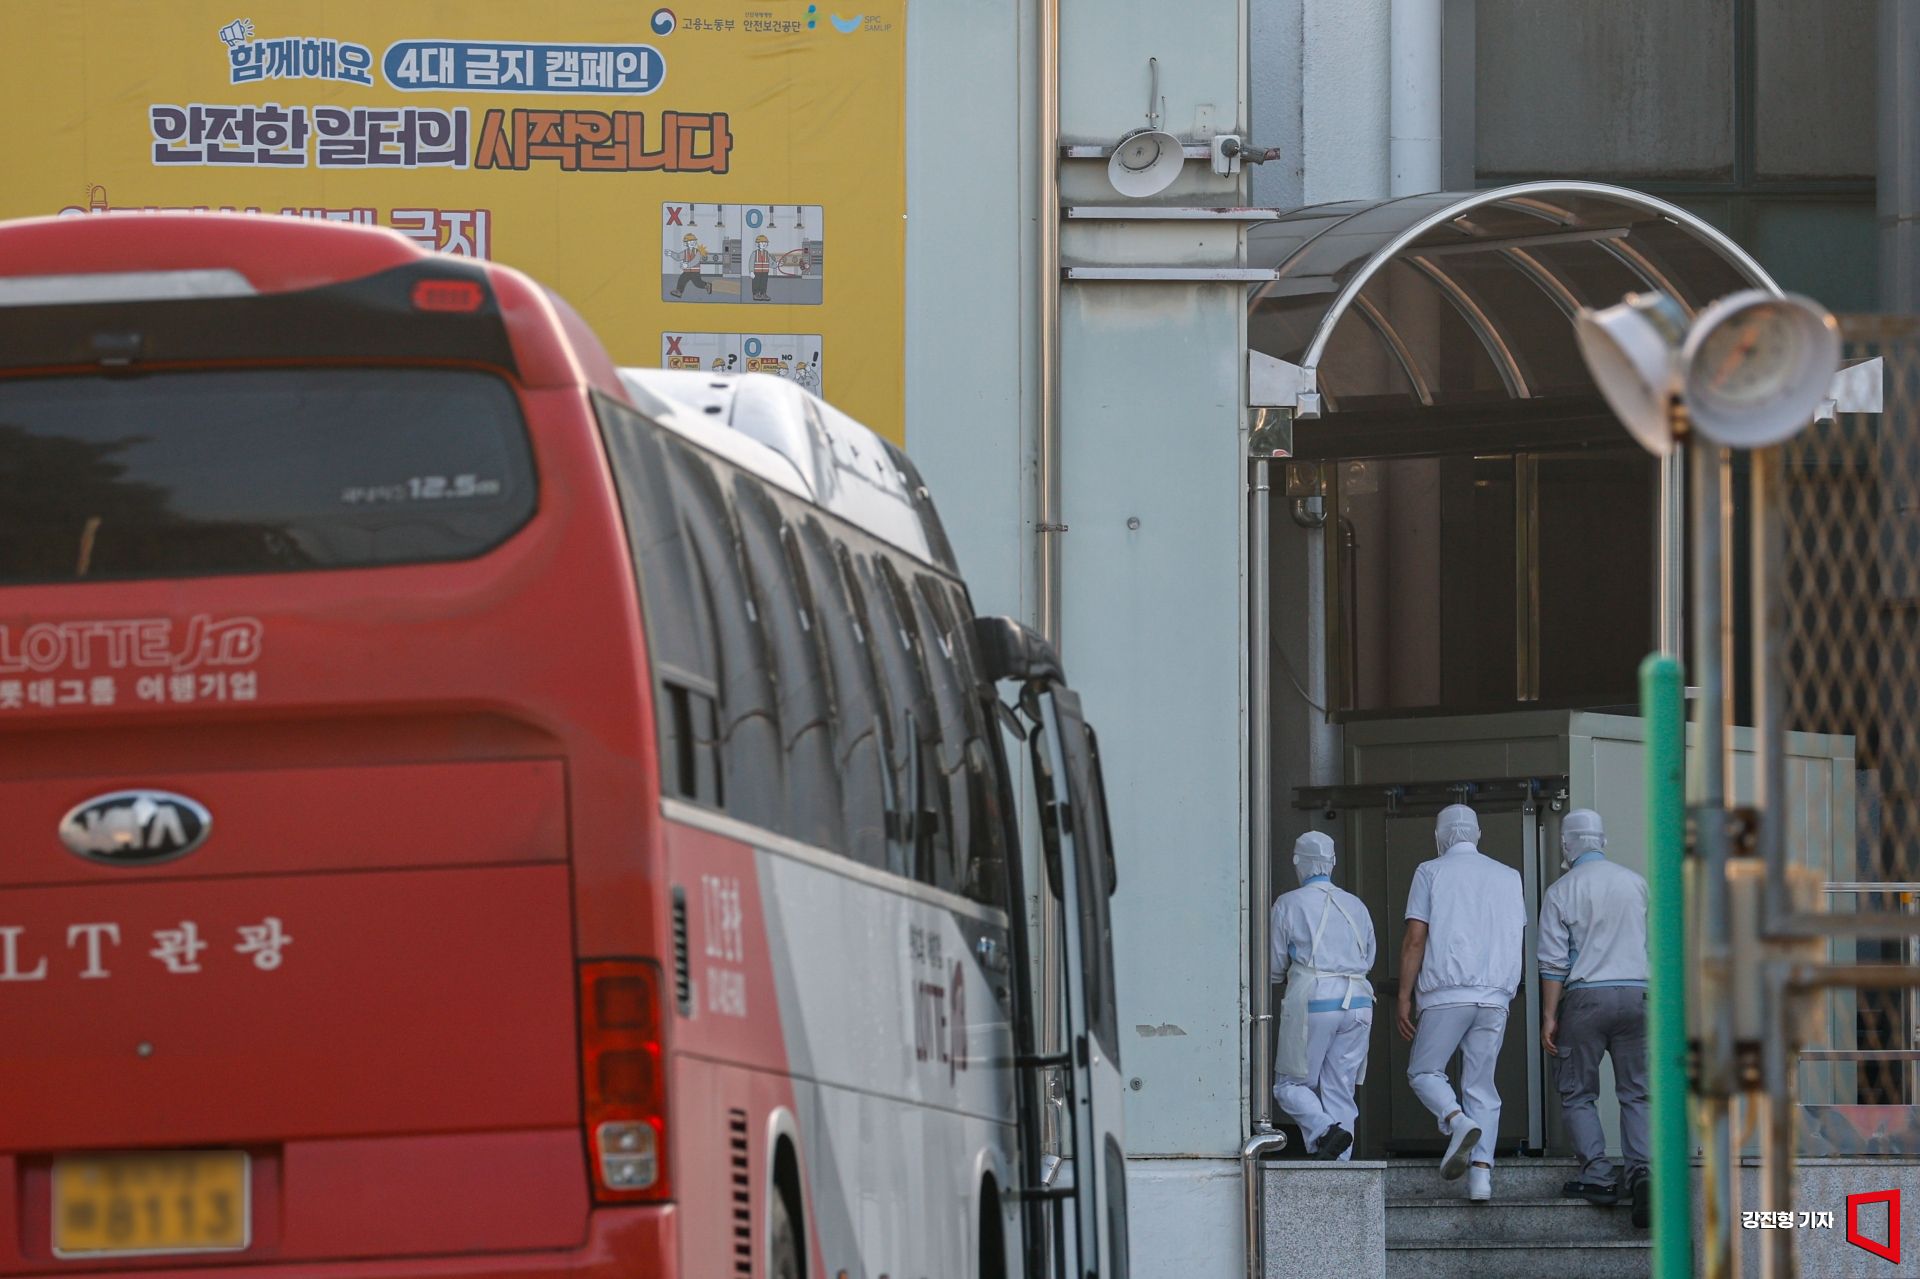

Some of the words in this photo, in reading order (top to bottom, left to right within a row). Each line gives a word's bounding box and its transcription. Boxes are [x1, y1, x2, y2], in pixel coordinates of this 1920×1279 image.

[682, 18, 735, 31] 고용노동부
[743, 19, 801, 33] 안전보건공단
[863, 15, 882, 24] SPC
[863, 24, 892, 33] SAMLIP
[229, 38, 374, 86] 함께해요
[396, 48, 454, 84] 4대
[466, 49, 535, 86] 금지
[546, 50, 649, 89] 캠페인
[150, 104, 309, 168] 안전한
[313, 106, 470, 169] 일터의
[475, 109, 732, 174] 시작입니다
[0, 617, 172, 672] LOTTE
[0, 675, 117, 708] 롯데그룹
[136, 670, 258, 703] 여행기업
